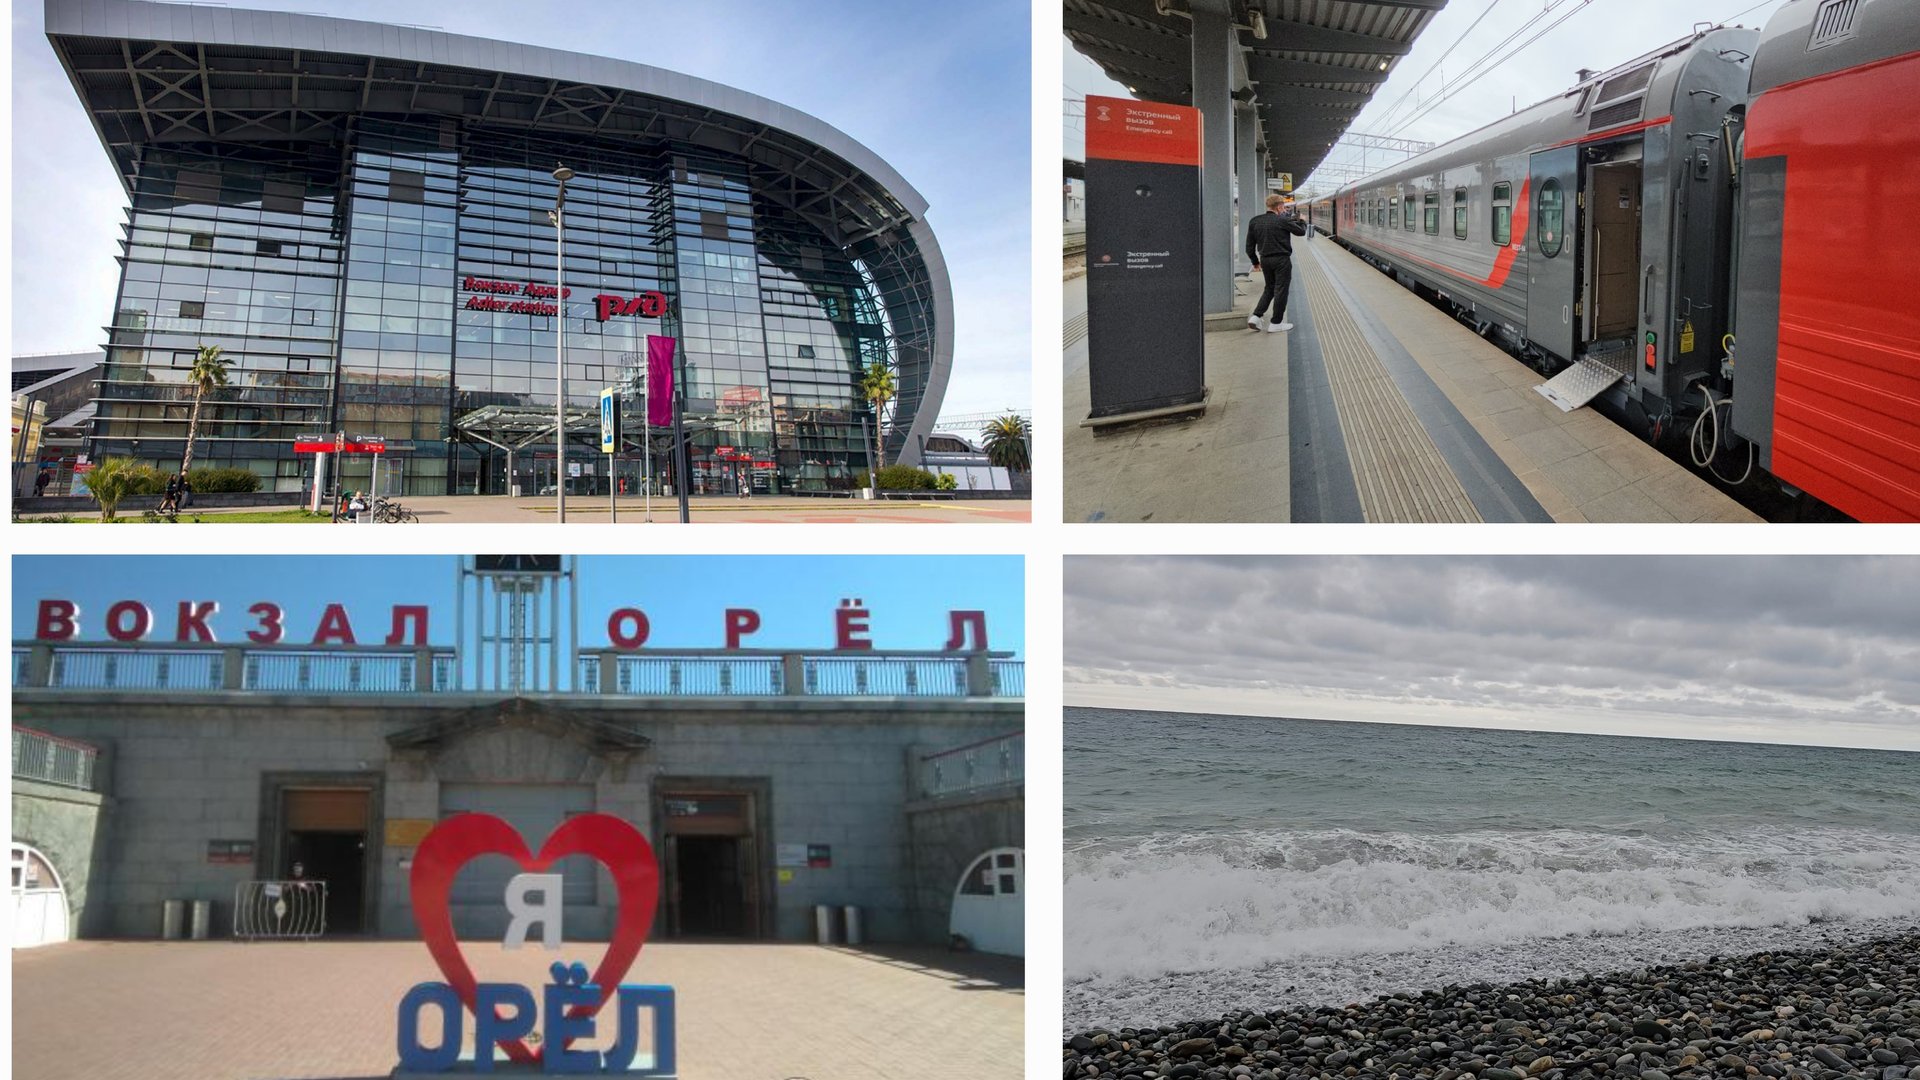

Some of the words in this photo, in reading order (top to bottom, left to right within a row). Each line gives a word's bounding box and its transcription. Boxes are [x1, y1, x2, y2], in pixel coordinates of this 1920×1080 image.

[1126, 108, 1181, 121] Экстренный
[1126, 117, 1154, 126] вызов
[1126, 125, 1161, 135] Emergency
[465, 275, 519, 292] Вокзал
[525, 281, 572, 299] Адлер
[467, 296, 508, 309] Adler
[36, 599, 429, 646] ВОКЗАЛ
[606, 598, 989, 650] ОРЁЛ
[503, 872, 563, 950] Я
[396, 960, 677, 1075] ОРЁЛ
